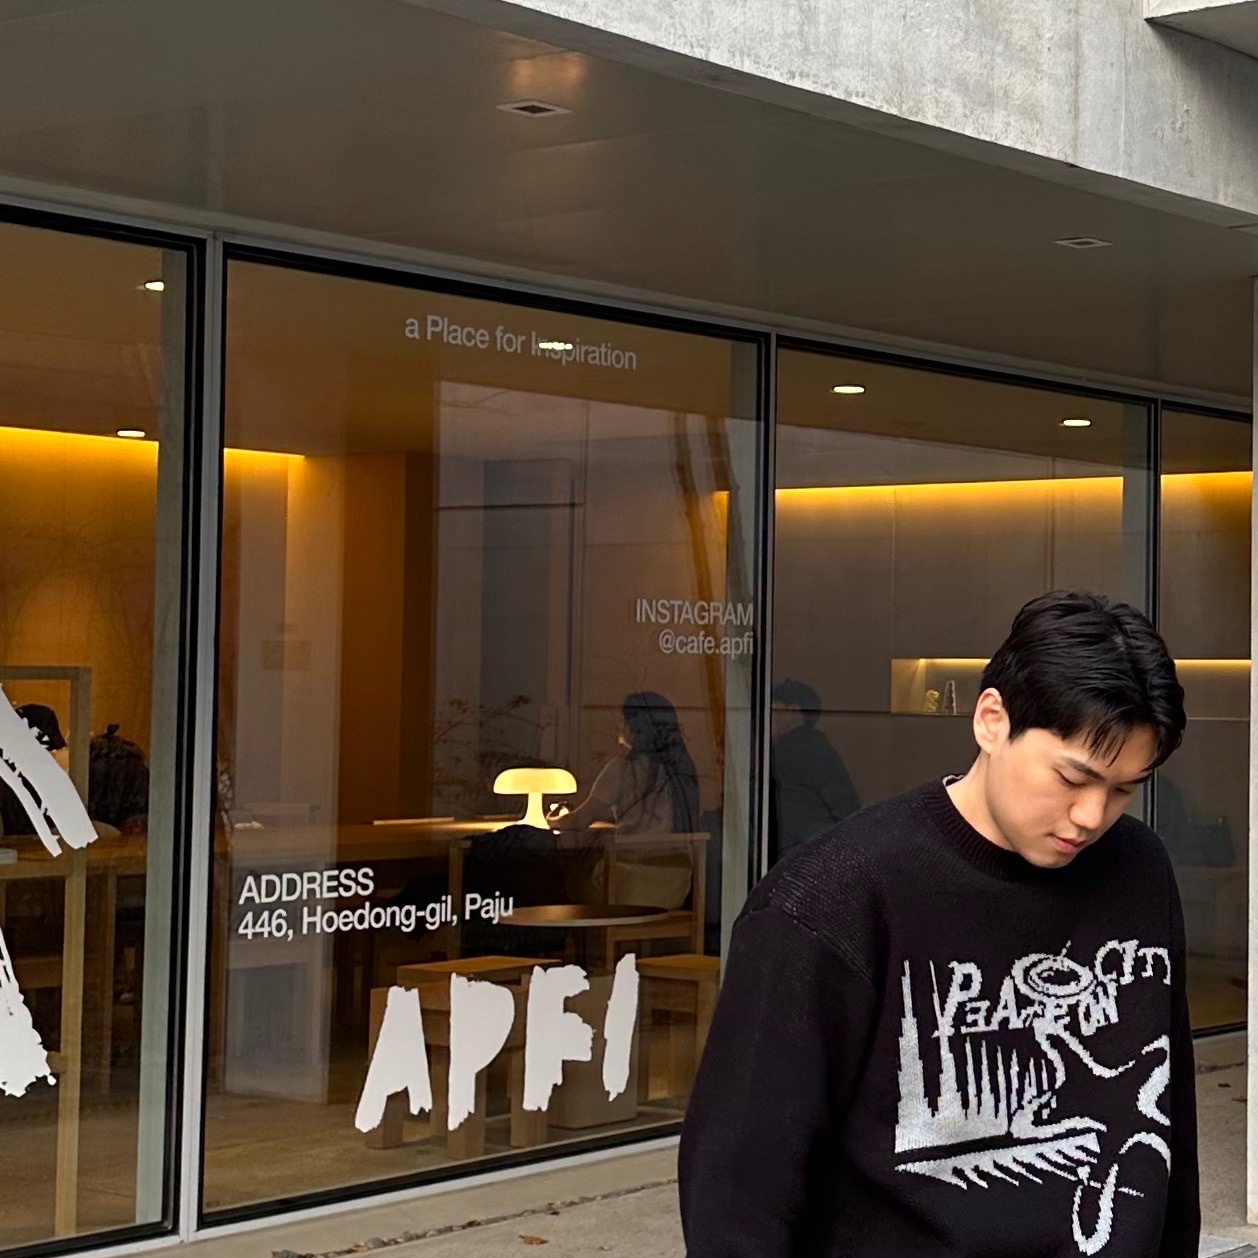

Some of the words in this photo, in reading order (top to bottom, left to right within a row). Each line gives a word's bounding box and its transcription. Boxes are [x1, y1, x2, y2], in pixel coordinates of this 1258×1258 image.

[404, 317, 420, 340] a
[426, 314, 490, 349] Place
[495, 326, 526, 354] for
[635, 598, 754, 627] INSTAGRAM
[658, 628, 754, 660] @cafe.apfi
[238, 867, 375, 905] ADDRESS
[237, 908, 294, 942] 446,
[301, 894, 458, 936] Hoedong-gil,
[464, 890, 514, 924] Paju
[354, 952, 640, 1134] APFI
